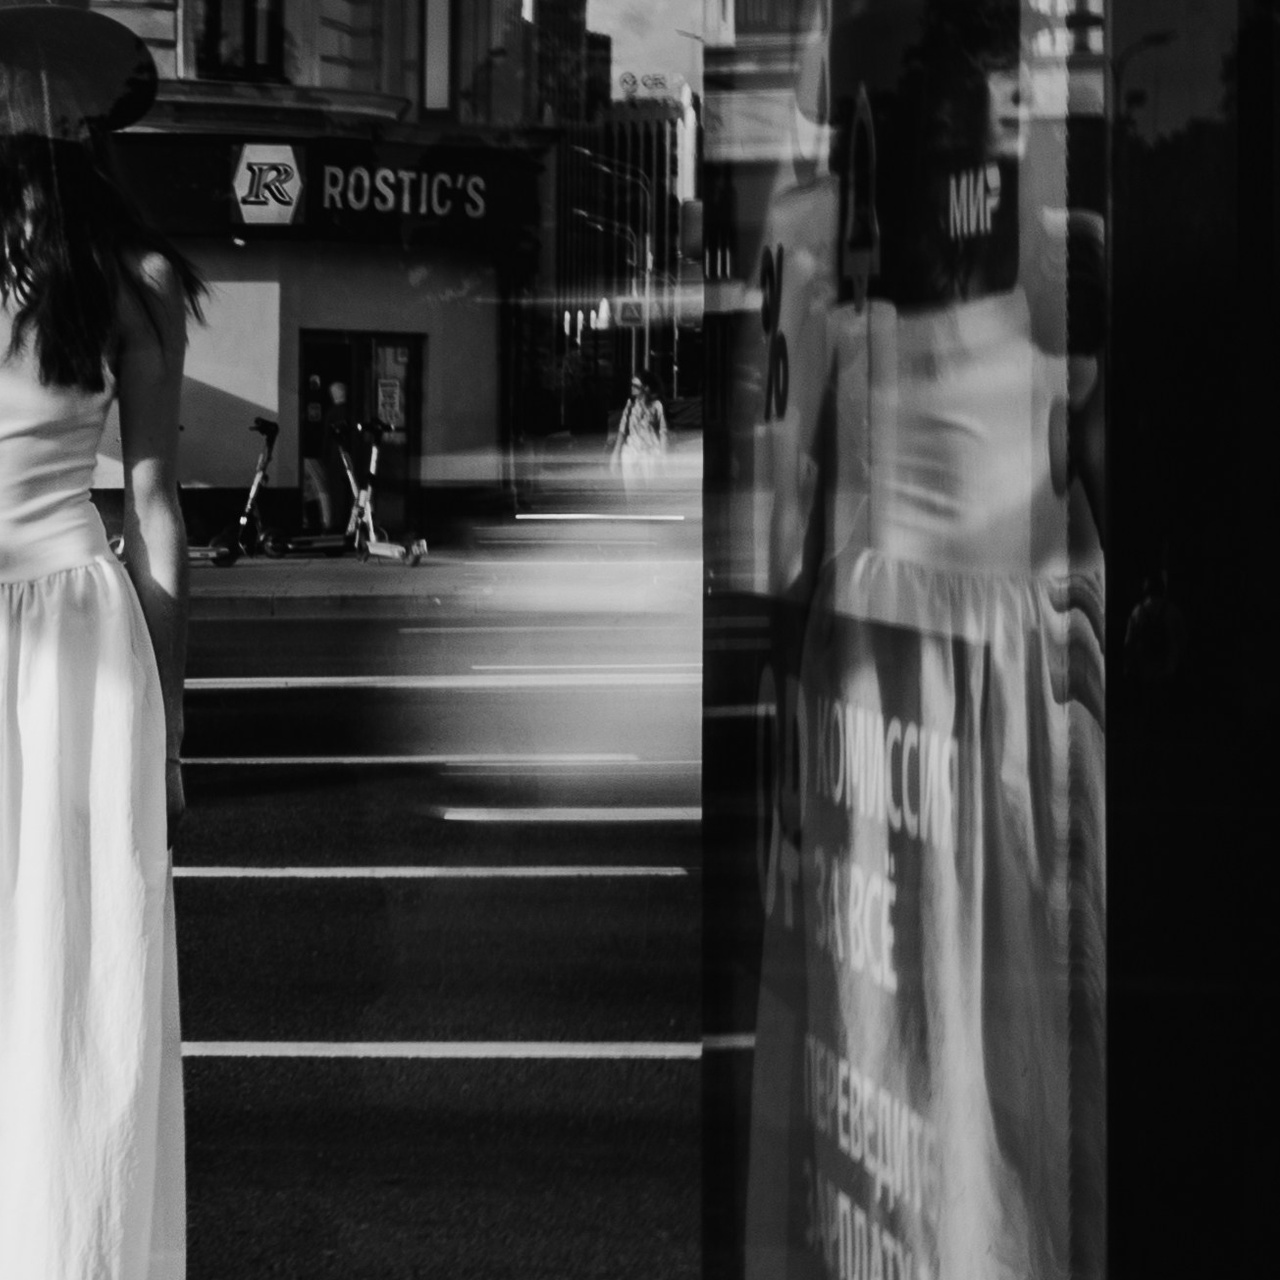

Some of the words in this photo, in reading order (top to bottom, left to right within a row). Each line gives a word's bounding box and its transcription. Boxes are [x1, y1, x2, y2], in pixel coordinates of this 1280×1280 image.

[241, 162, 296, 206] R
[323, 166, 486, 217] ROSTIC'S
[816, 695, 959, 855] КОМИССИЯ
